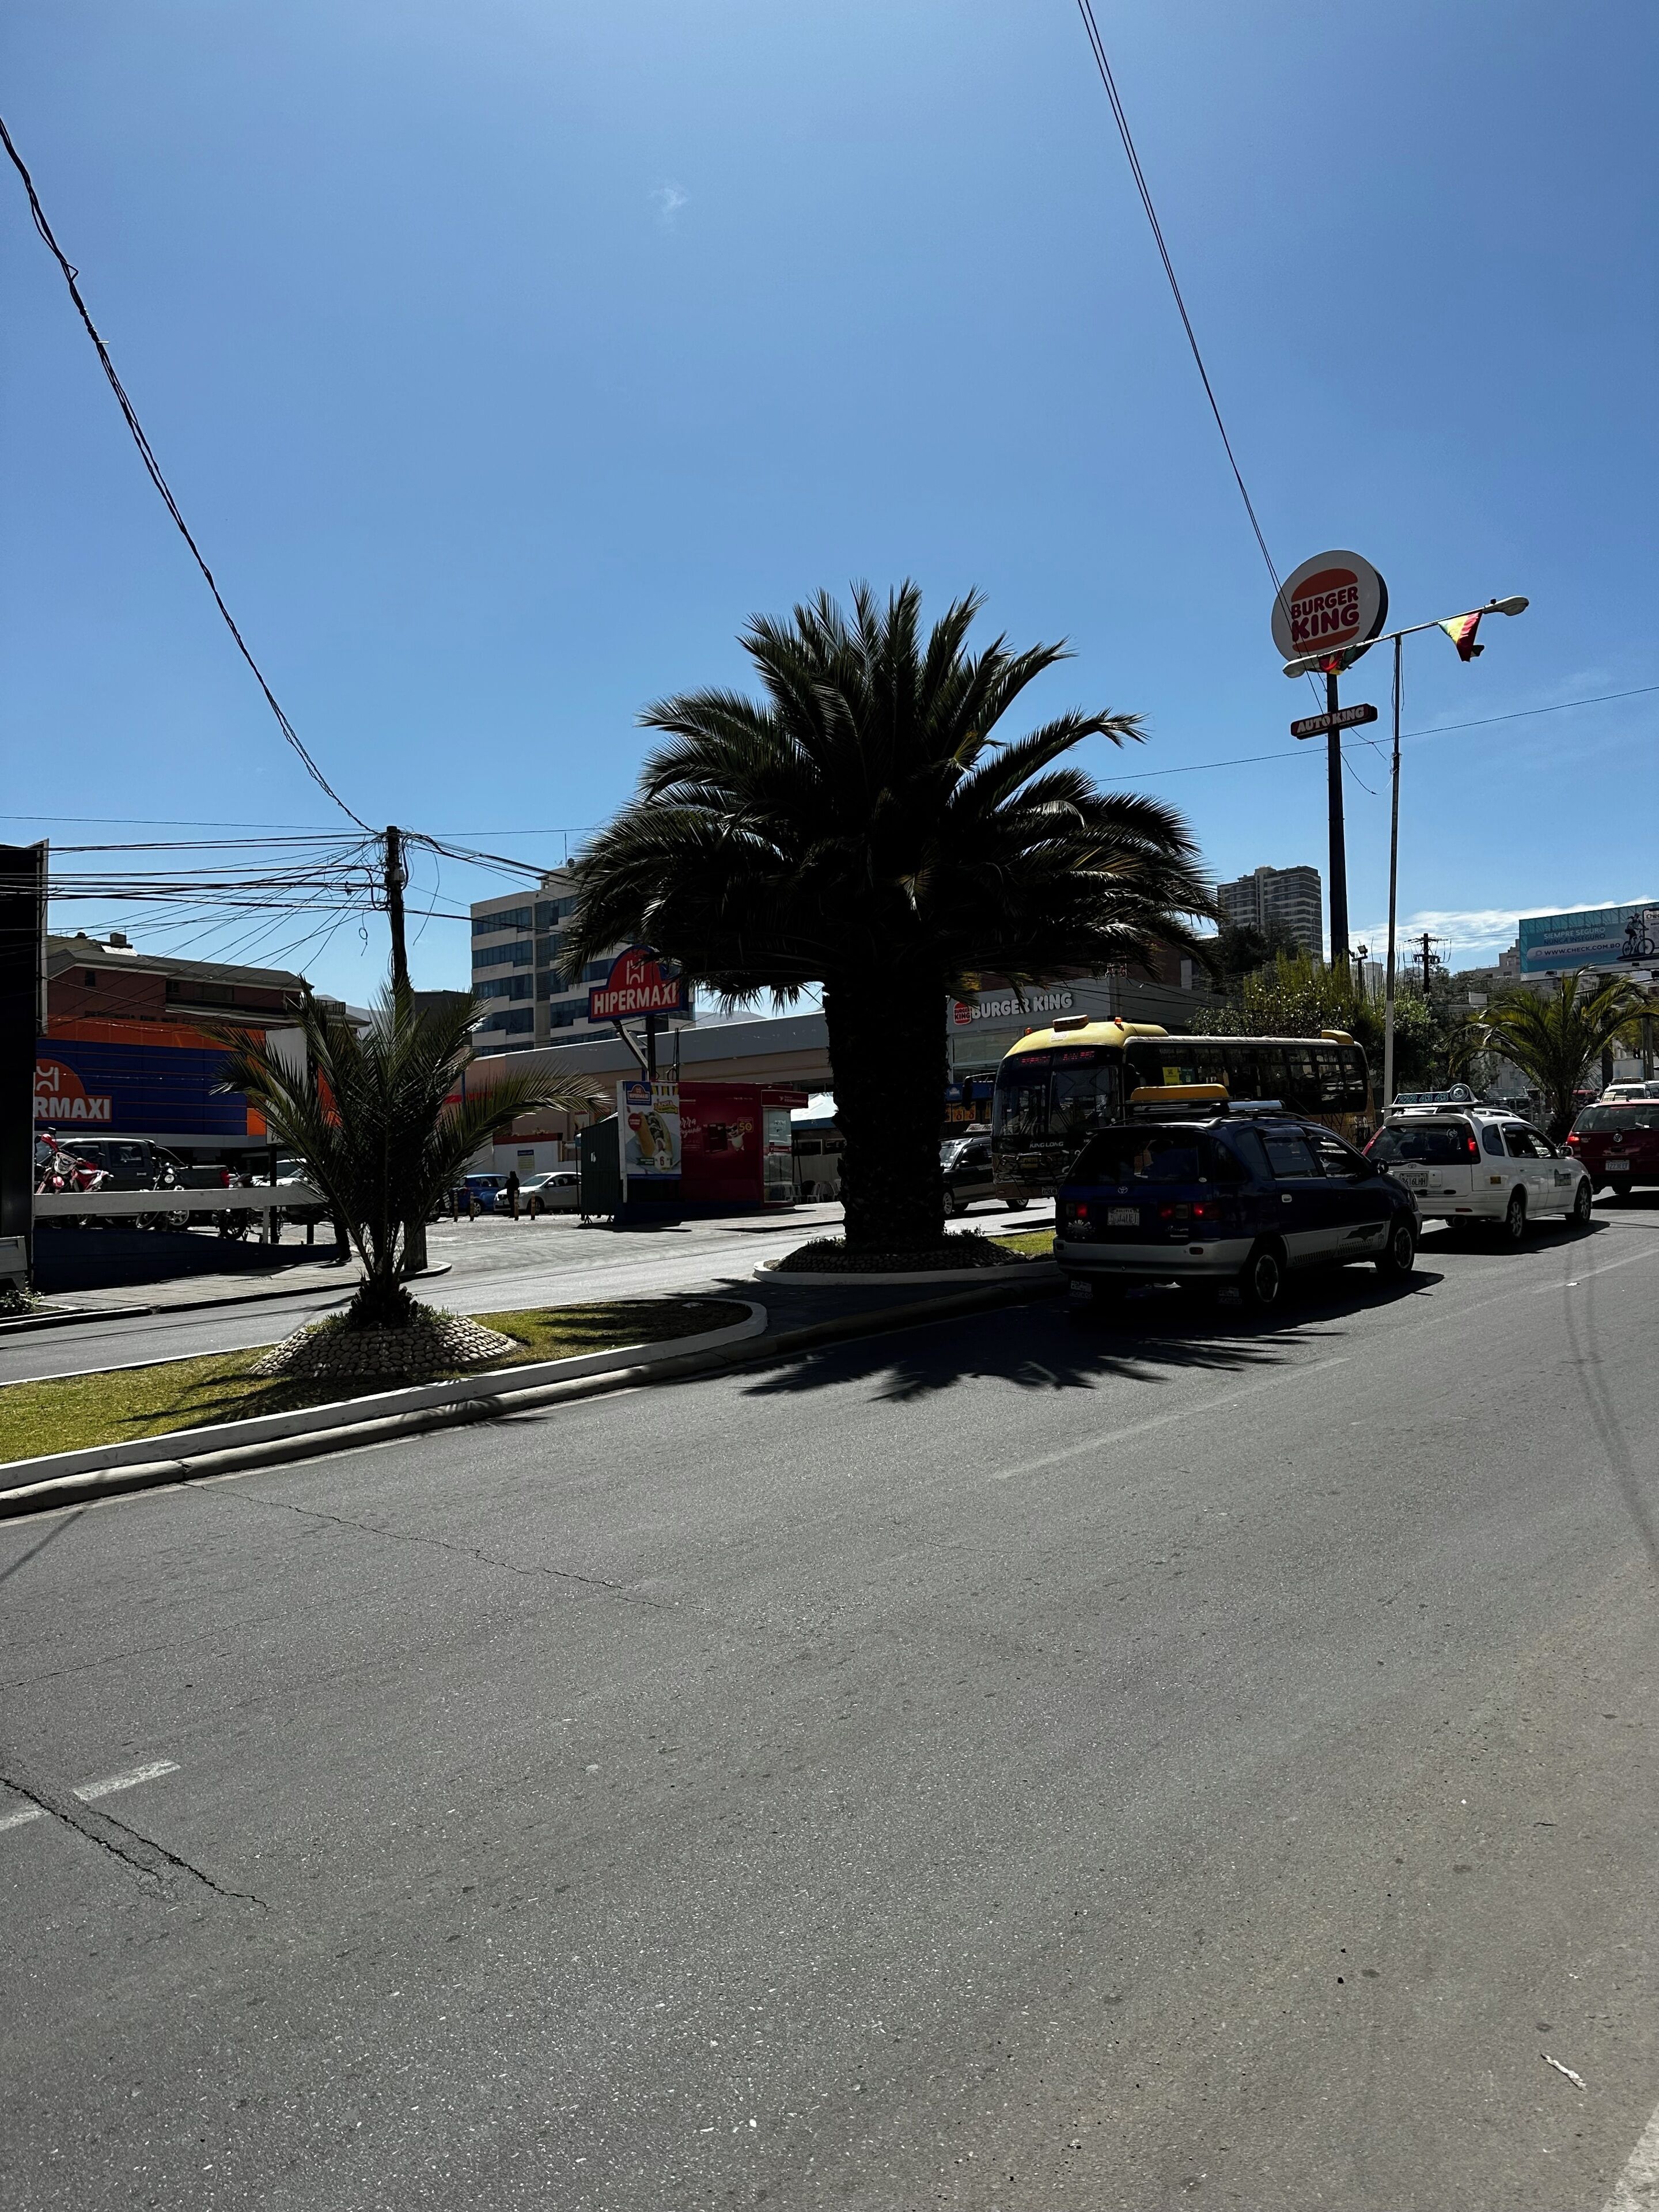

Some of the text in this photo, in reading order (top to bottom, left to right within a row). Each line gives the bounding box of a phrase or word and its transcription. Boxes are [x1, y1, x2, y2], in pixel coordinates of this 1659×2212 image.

[1291, 586, 1358, 619] BURGER
[1292, 603, 1359, 642] KING
[1297, 707, 1365, 733] AUTO KING
[1544, 930, 1574, 940] SIEMPRE
[1575, 927, 1605, 935] SEGURO
[1570, 933, 1605, 942] INSEGURO
[1544, 942, 1620, 955] WWW.CHECK.COM.BO
[594, 982, 676, 1015] HIPERMAXI
[972, 993, 1073, 1019] BURGER KING
[955, 1012, 971, 1020] KING
[35, 1096, 110, 1119] RMAXI
[1398, 1094, 1418, 1104] 222
[739, 1122, 752, 1131] 50
